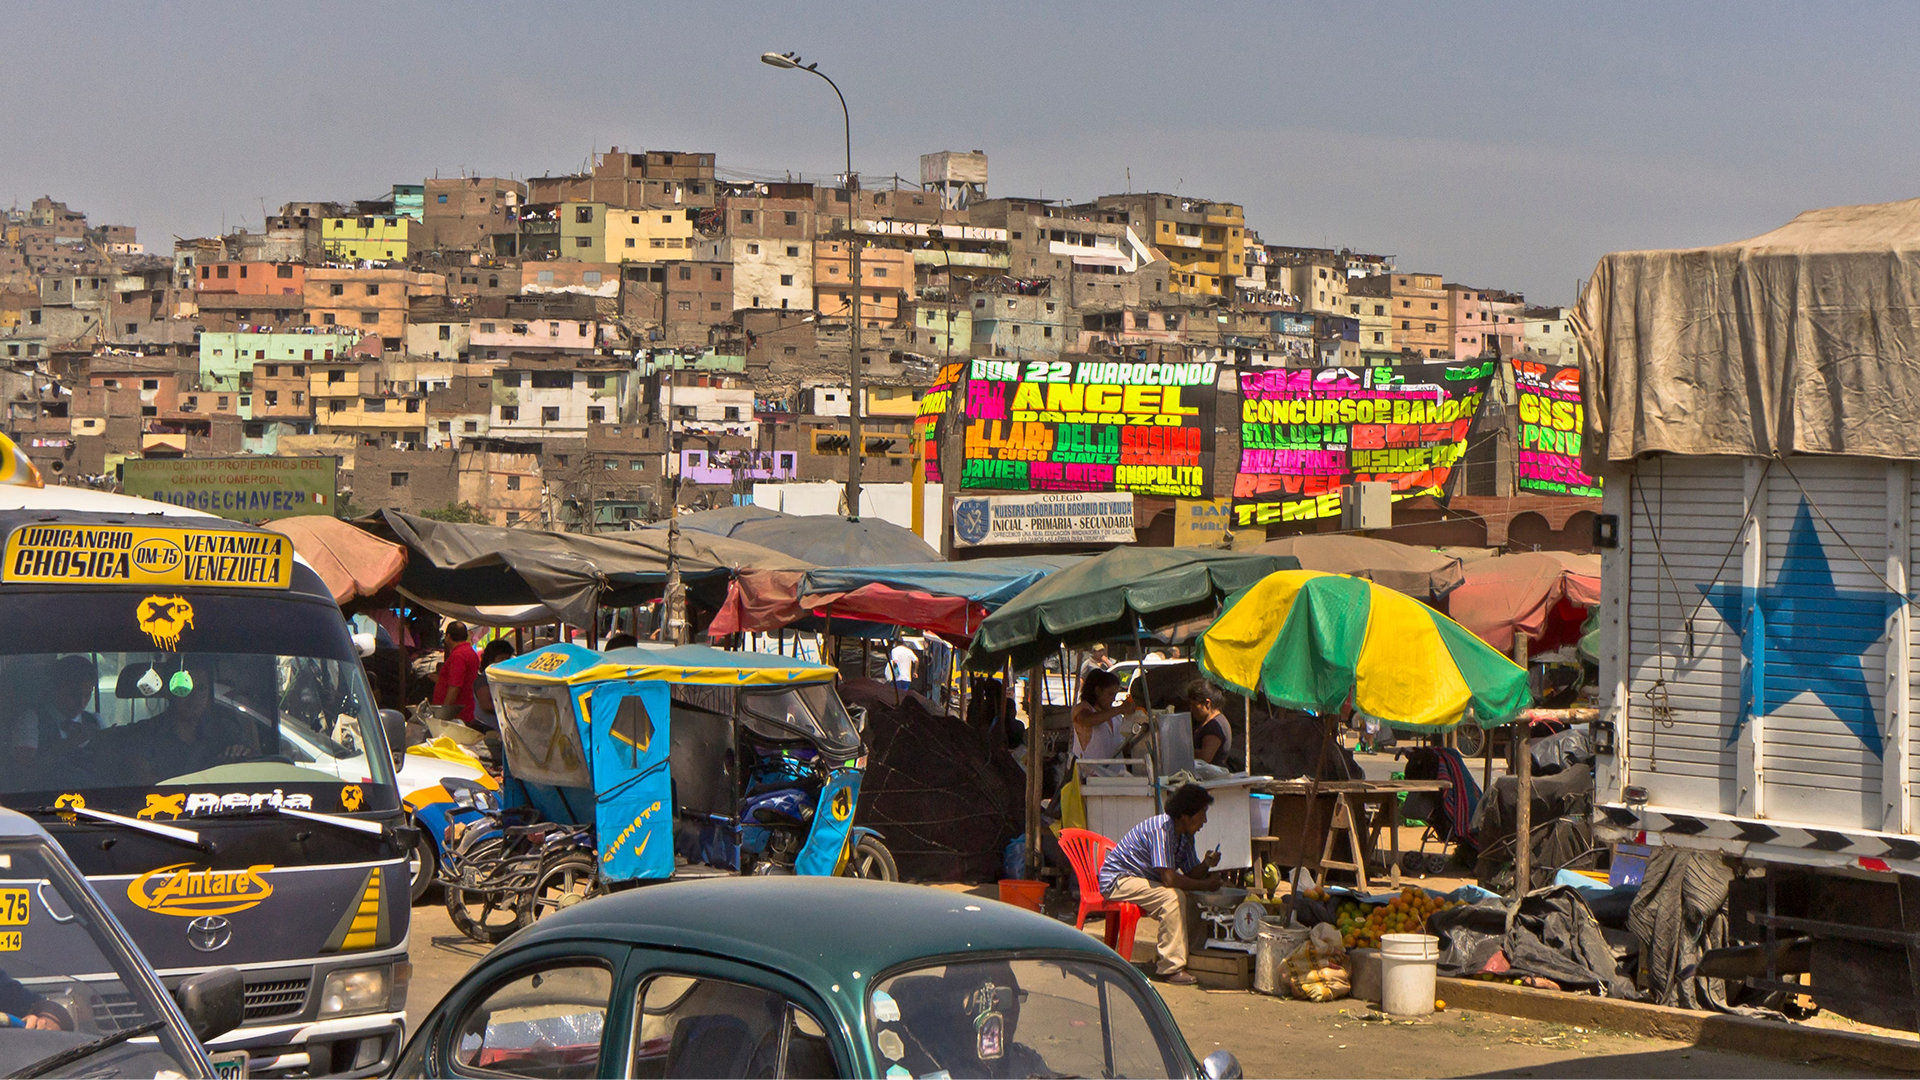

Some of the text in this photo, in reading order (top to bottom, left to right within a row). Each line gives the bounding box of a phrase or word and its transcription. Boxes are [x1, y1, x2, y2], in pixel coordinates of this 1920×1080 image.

[1024, 361, 1073, 383] 22
[1075, 362, 1217, 386] HUAROCONDO
[1010, 381, 1199, 416] ANGEL
[1012, 410, 1183, 427] DAMAZO
[1242, 399, 1374, 424] CONCURSO
[1374, 398, 1392, 424] DE
[1274, 424, 1349, 444] LUCIA
[965, 447, 1048, 462] DEL CUSCO
[1052, 451, 1120, 464] CHAVEZ
[201, 460, 215, 471] DE
[217, 459, 298, 471] PROPIETARIOS
[300, 460, 323, 470] DEL
[962, 459, 1028, 479] JAVIER
[171, 475, 284, 485] CENTRO COMERCIAL
[1042, 494, 1084, 503] COLEGIO
[1026, 501, 1053, 517] SEÑORA
[1053, 503, 1067, 516] DEL
[1067, 502, 1098, 516] ROSARIO
[1098, 502, 1109, 515] DE
[992, 516, 1134, 531] INICIAL PRIMARIA SECUNDARIA
[18, 528, 133, 551] LURIGANCHO
[183, 534, 282, 556] VENTANILLA
[14, 549, 131, 579] CHOSICA
[136, 546, 178, 565] OM-75
[183, 555, 280, 583] VENEZUELA
